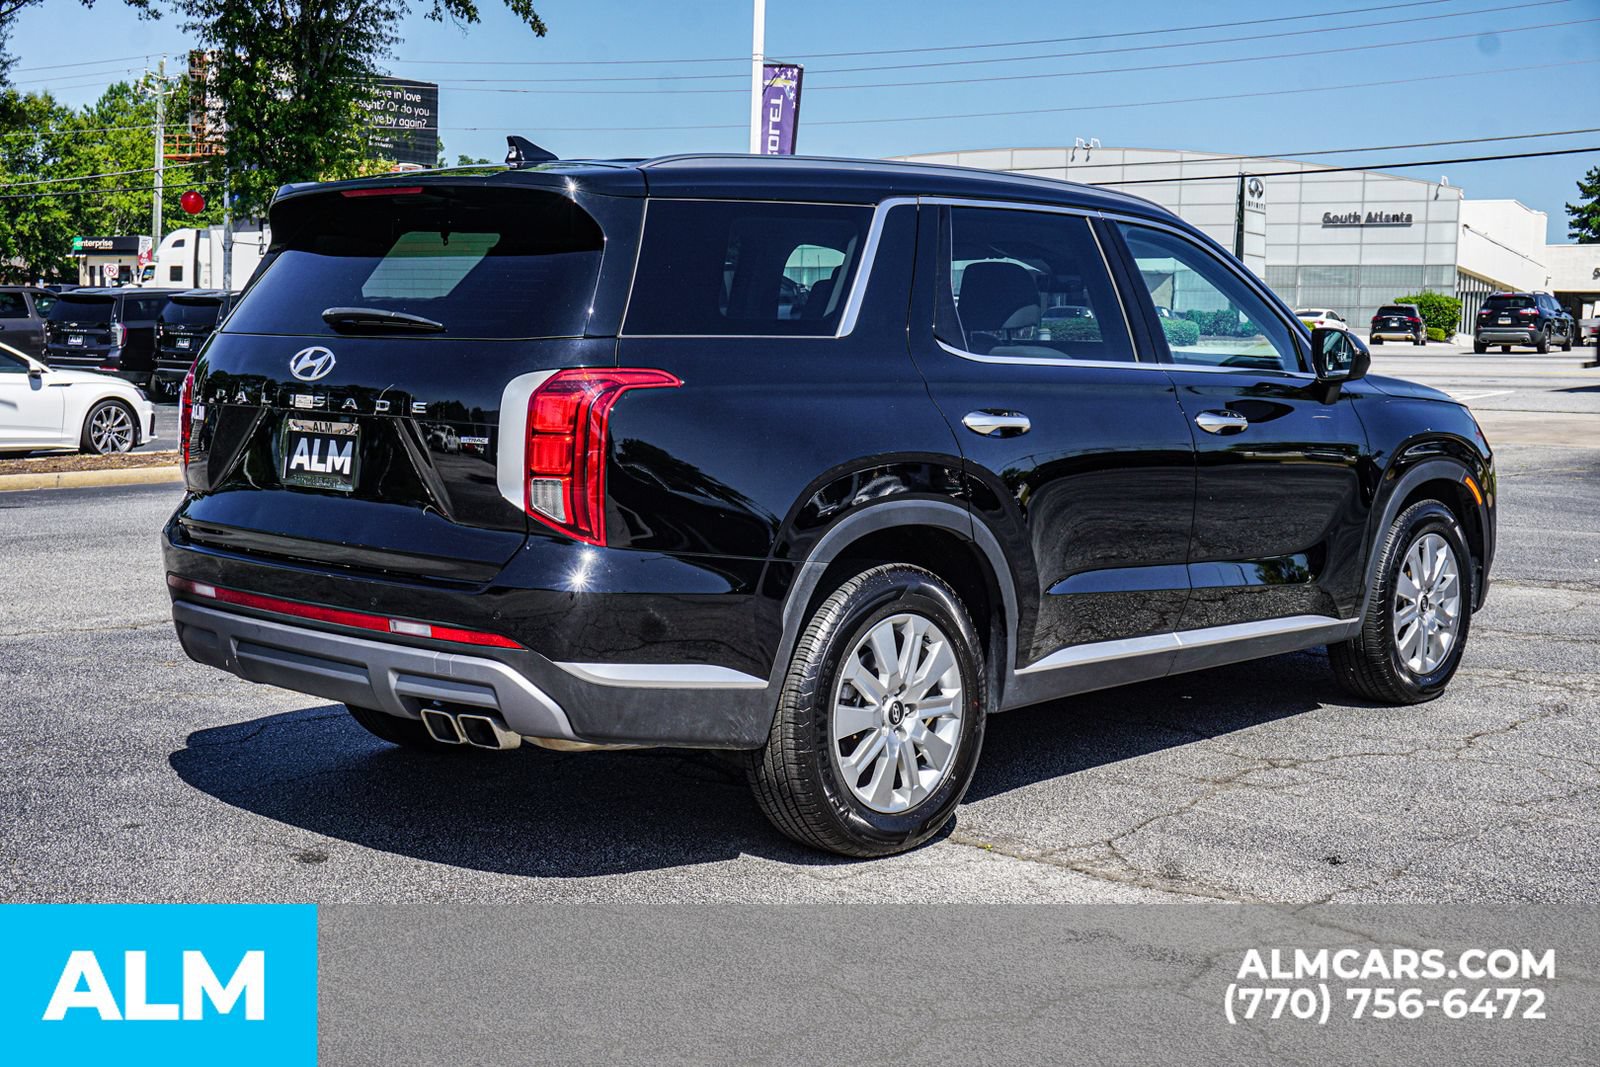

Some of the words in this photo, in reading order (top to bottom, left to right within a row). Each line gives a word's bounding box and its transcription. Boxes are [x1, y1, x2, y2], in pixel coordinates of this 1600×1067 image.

[394, 90, 402, 99] in
[403, 90, 421, 102] love
[387, 101, 399, 112] Or
[400, 103, 412, 114] do
[414, 107, 430, 117] you
[386, 114, 397, 127] by
[398, 117, 427, 129] again?
[1322, 211, 1361, 224] South
[1365, 211, 1413, 223] Atlanta
[76, 239, 113, 249] enterprise
[216, 388, 428, 414] PALISADE
[313, 421, 333, 433] ALM
[290, 437, 353, 475] ALM
